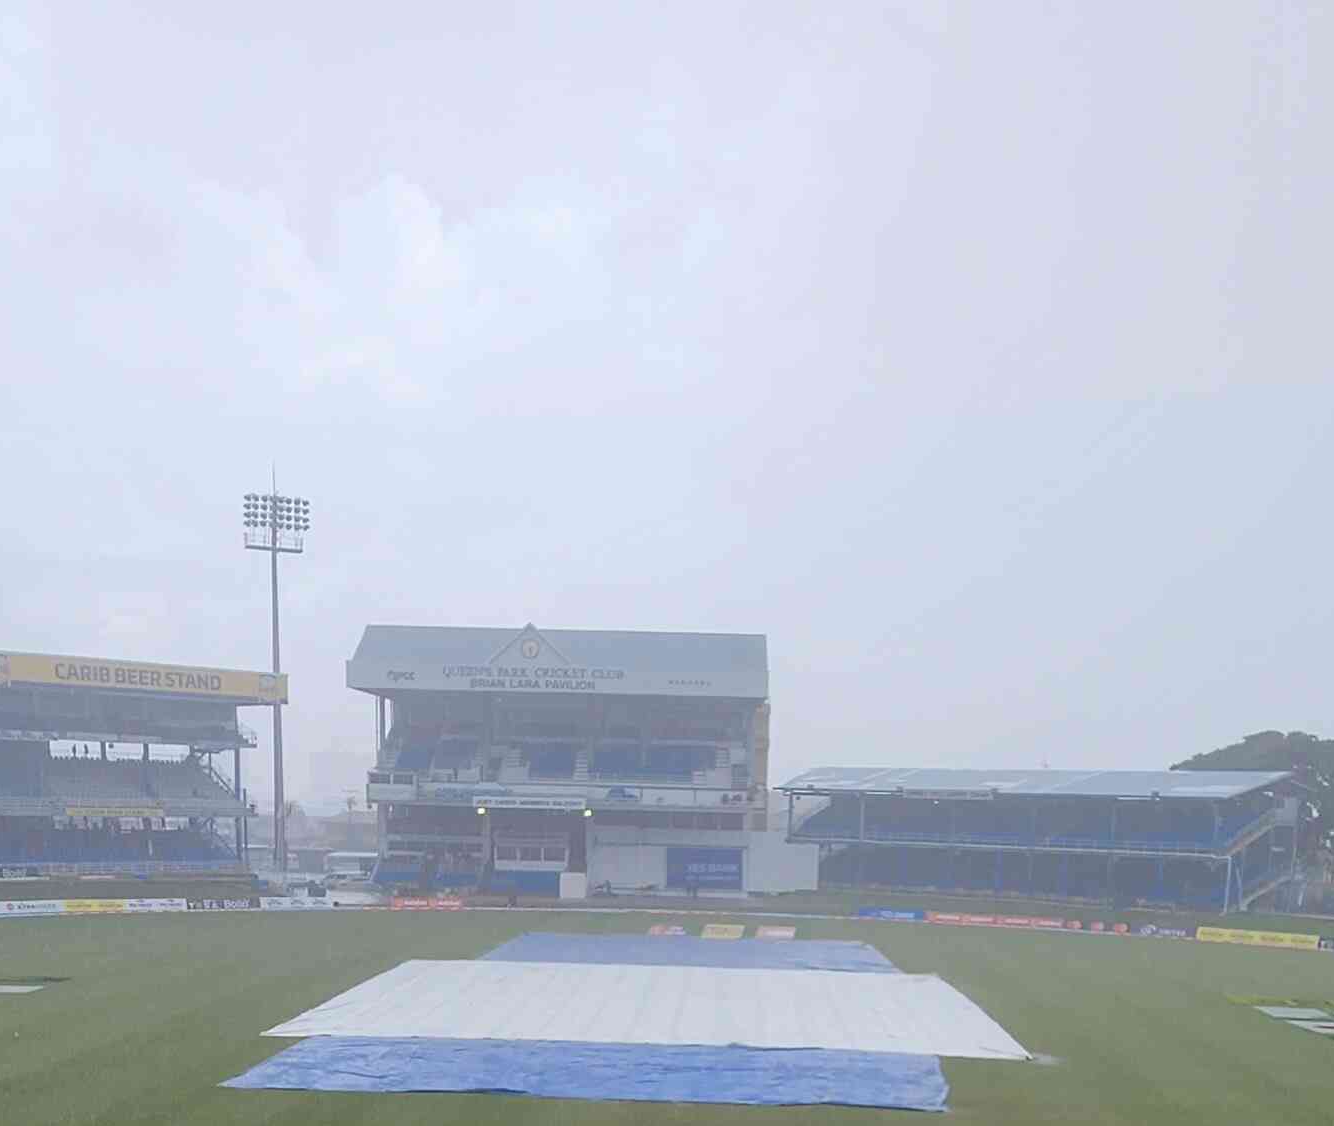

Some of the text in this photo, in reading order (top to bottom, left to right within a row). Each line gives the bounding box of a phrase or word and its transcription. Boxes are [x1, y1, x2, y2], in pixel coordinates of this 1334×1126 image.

[55, 663, 222, 691] CARIB BEER STAND
[499, 667, 530, 679] PARK
[534, 667, 588, 680] CRICKET
[591, 668, 624, 680] CLUB
[470, 678, 595, 690] BRIAN LARA PAVILION
